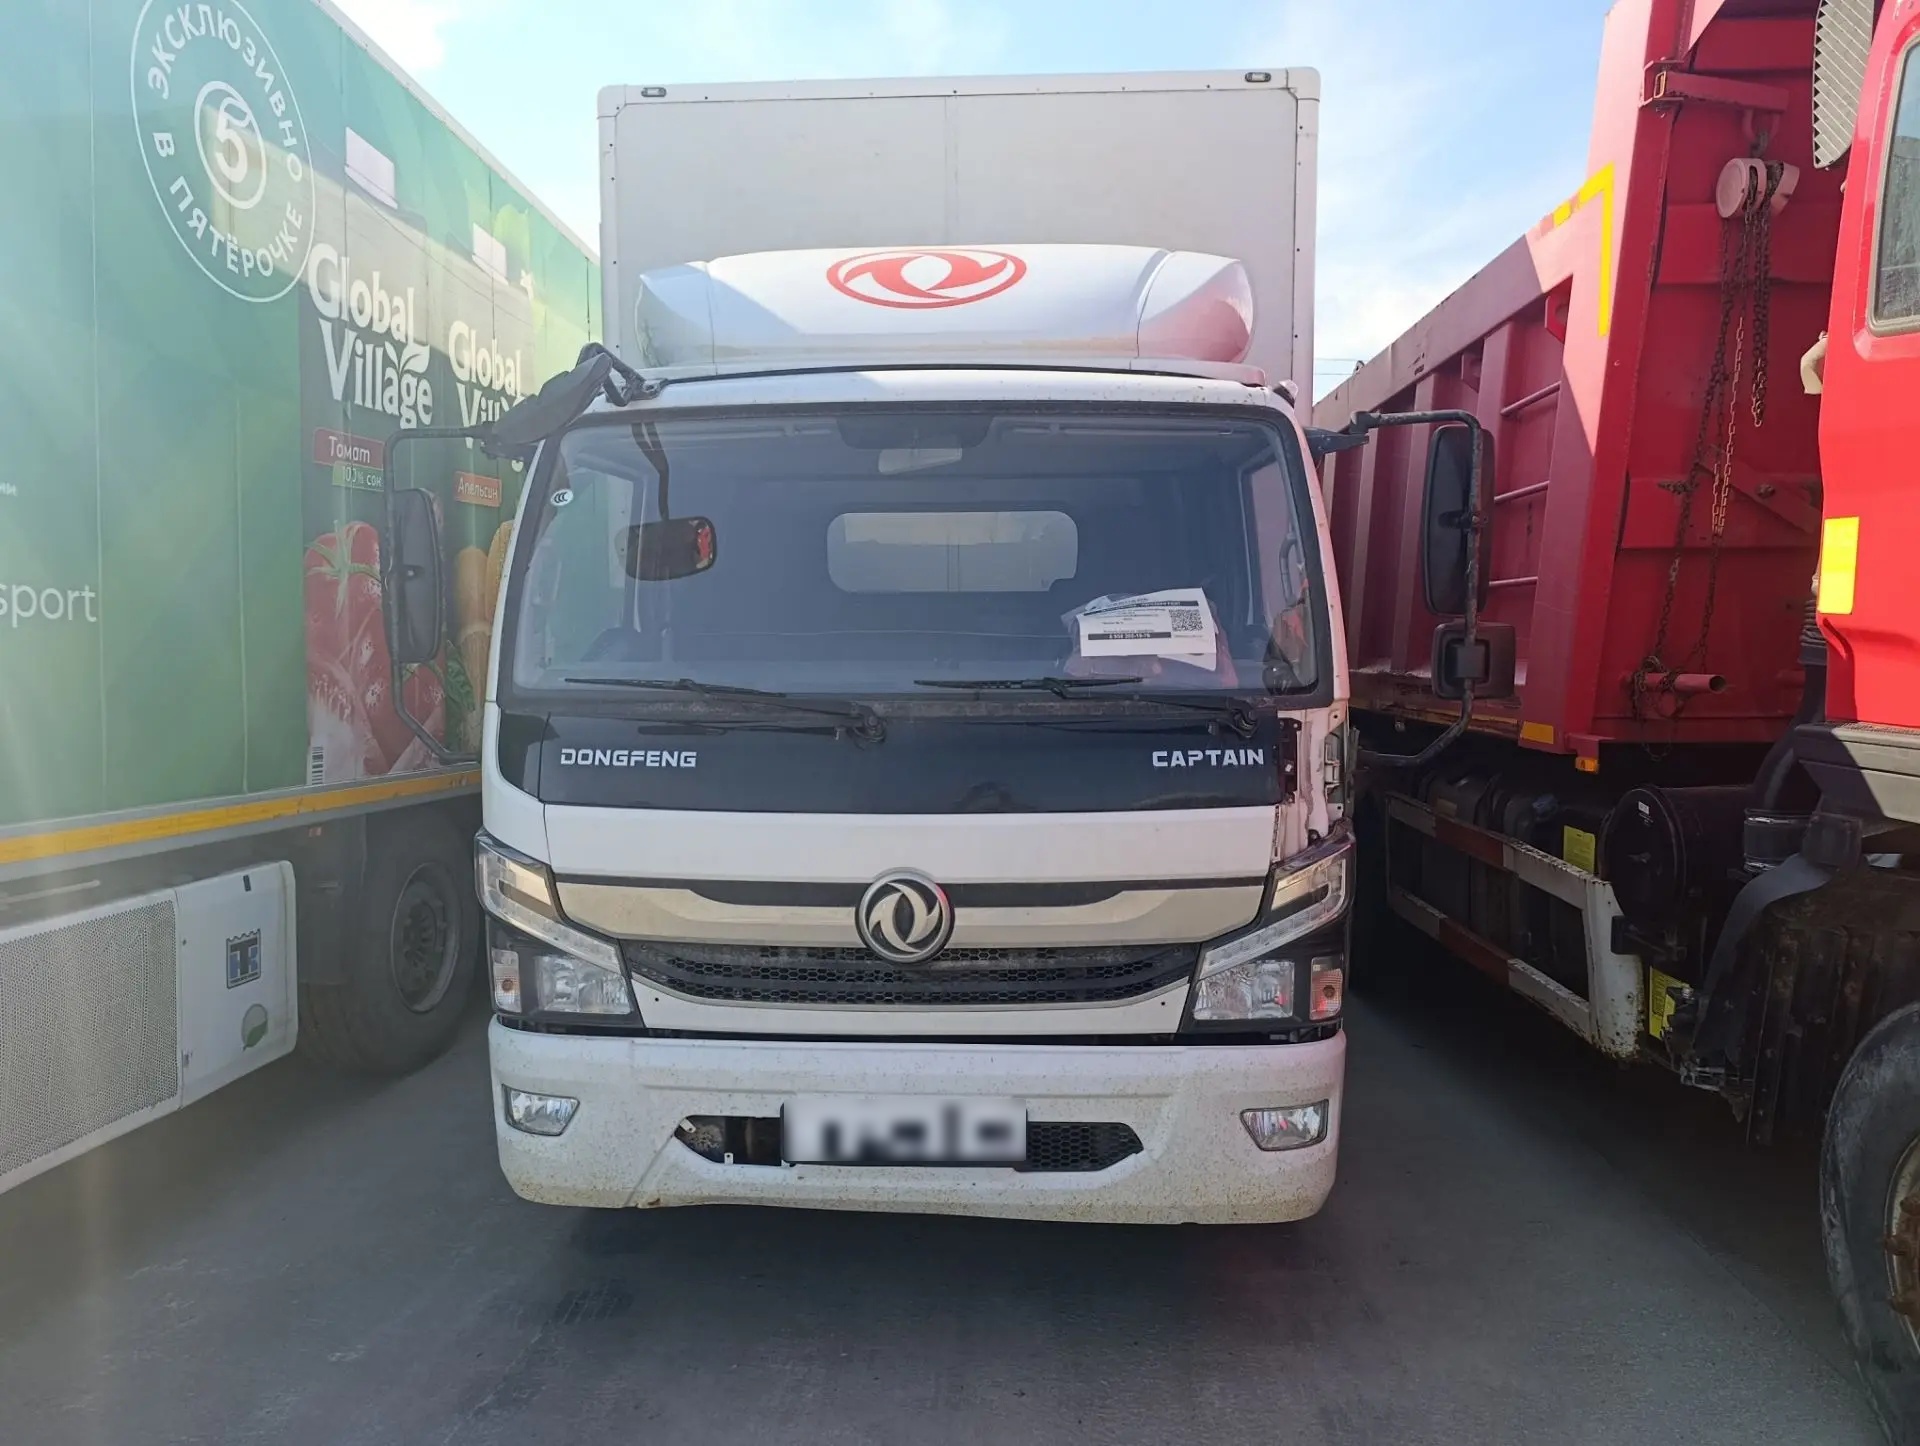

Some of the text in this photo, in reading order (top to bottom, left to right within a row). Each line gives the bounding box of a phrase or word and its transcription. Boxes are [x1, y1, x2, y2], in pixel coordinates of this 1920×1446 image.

[147, 2, 302, 181] ЭКСКЛЮЗИВНО
[153, 132, 302, 278] В ПЯТЁРОЧКЕ
[307, 243, 415, 345] Global
[318, 318, 433, 430] Village
[449, 320, 522, 398] Global
[328, 435, 370, 463] Томат
[457, 476, 498, 499] Апельсин
[560, 748, 697, 767] DONGFENG
[1152, 749, 1264, 767] CAPTAIN
